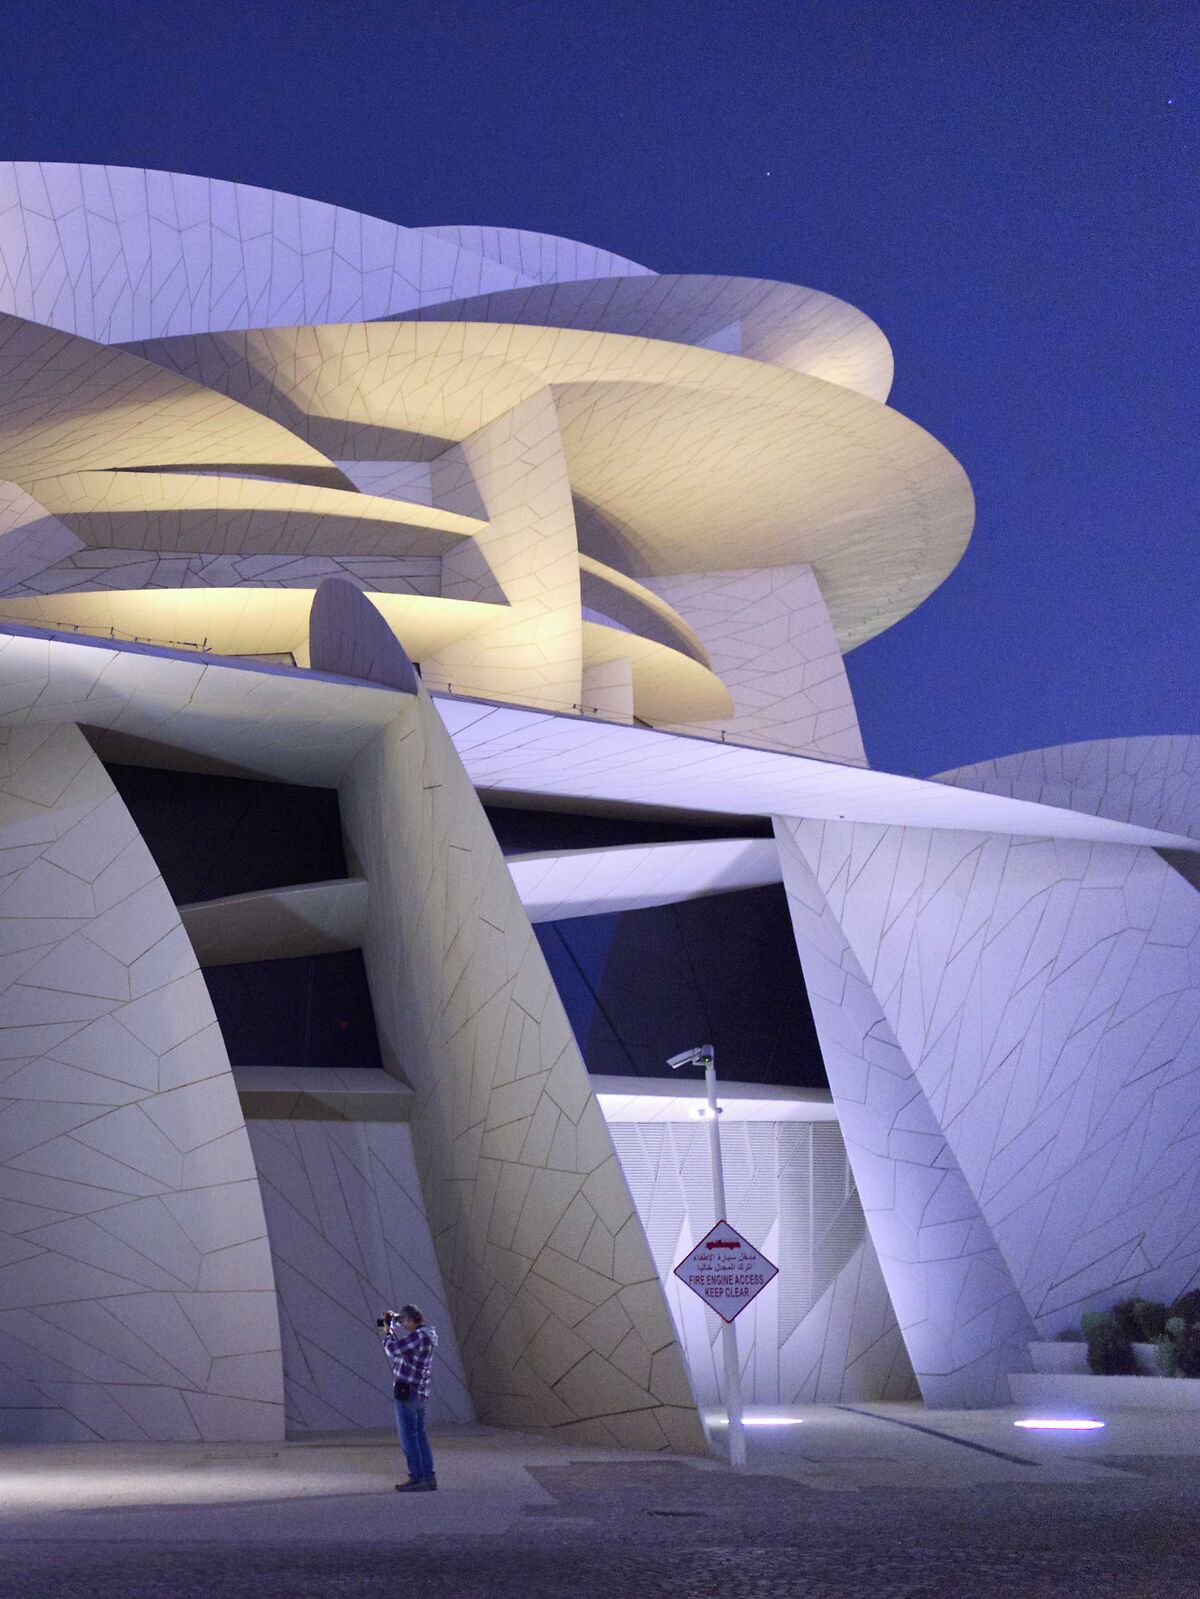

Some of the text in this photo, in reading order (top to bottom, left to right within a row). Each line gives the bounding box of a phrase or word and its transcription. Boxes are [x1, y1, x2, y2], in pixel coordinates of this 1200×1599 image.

[689, 1274, 764, 1286] FIRE ENGINE ACCESS
[705, 1287, 749, 1298] KEEP CLEAR
